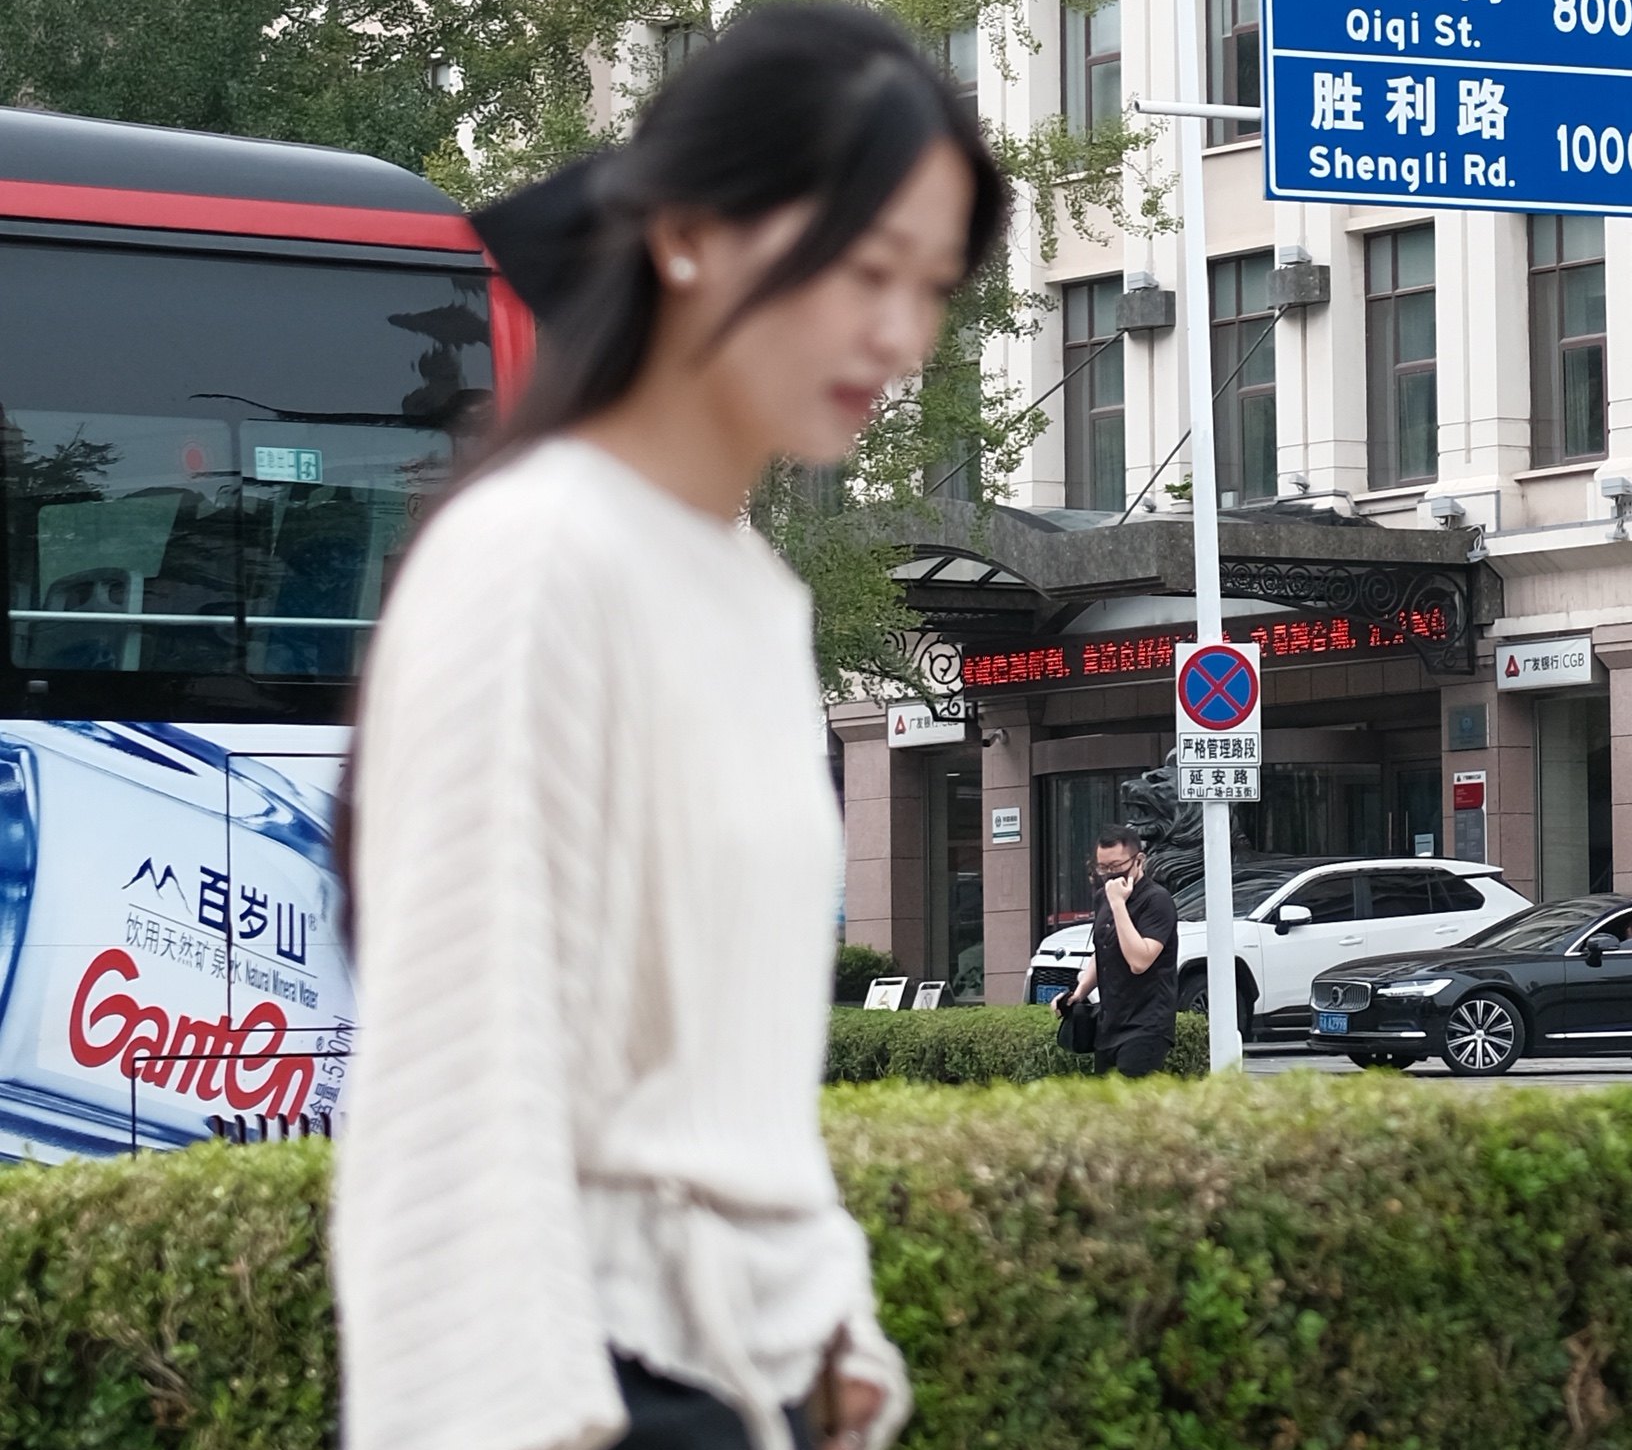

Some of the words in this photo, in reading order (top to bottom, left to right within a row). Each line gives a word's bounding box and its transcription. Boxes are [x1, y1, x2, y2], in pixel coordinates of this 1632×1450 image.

[1346, 8, 1421, 51] Qiqi
[1433, 14, 1481, 49] St.
[1310, 71, 1510, 141] 胜利路
[1308, 145, 1448, 193] Shengli
[1464, 154, 1517, 188] Rd.
[1562, 652, 1585, 668] CGB
[1182, 737, 1256, 759] 严格管理路段
[1189, 769, 1248, 785] 延安路
[198, 866, 306, 966] 百岁山
